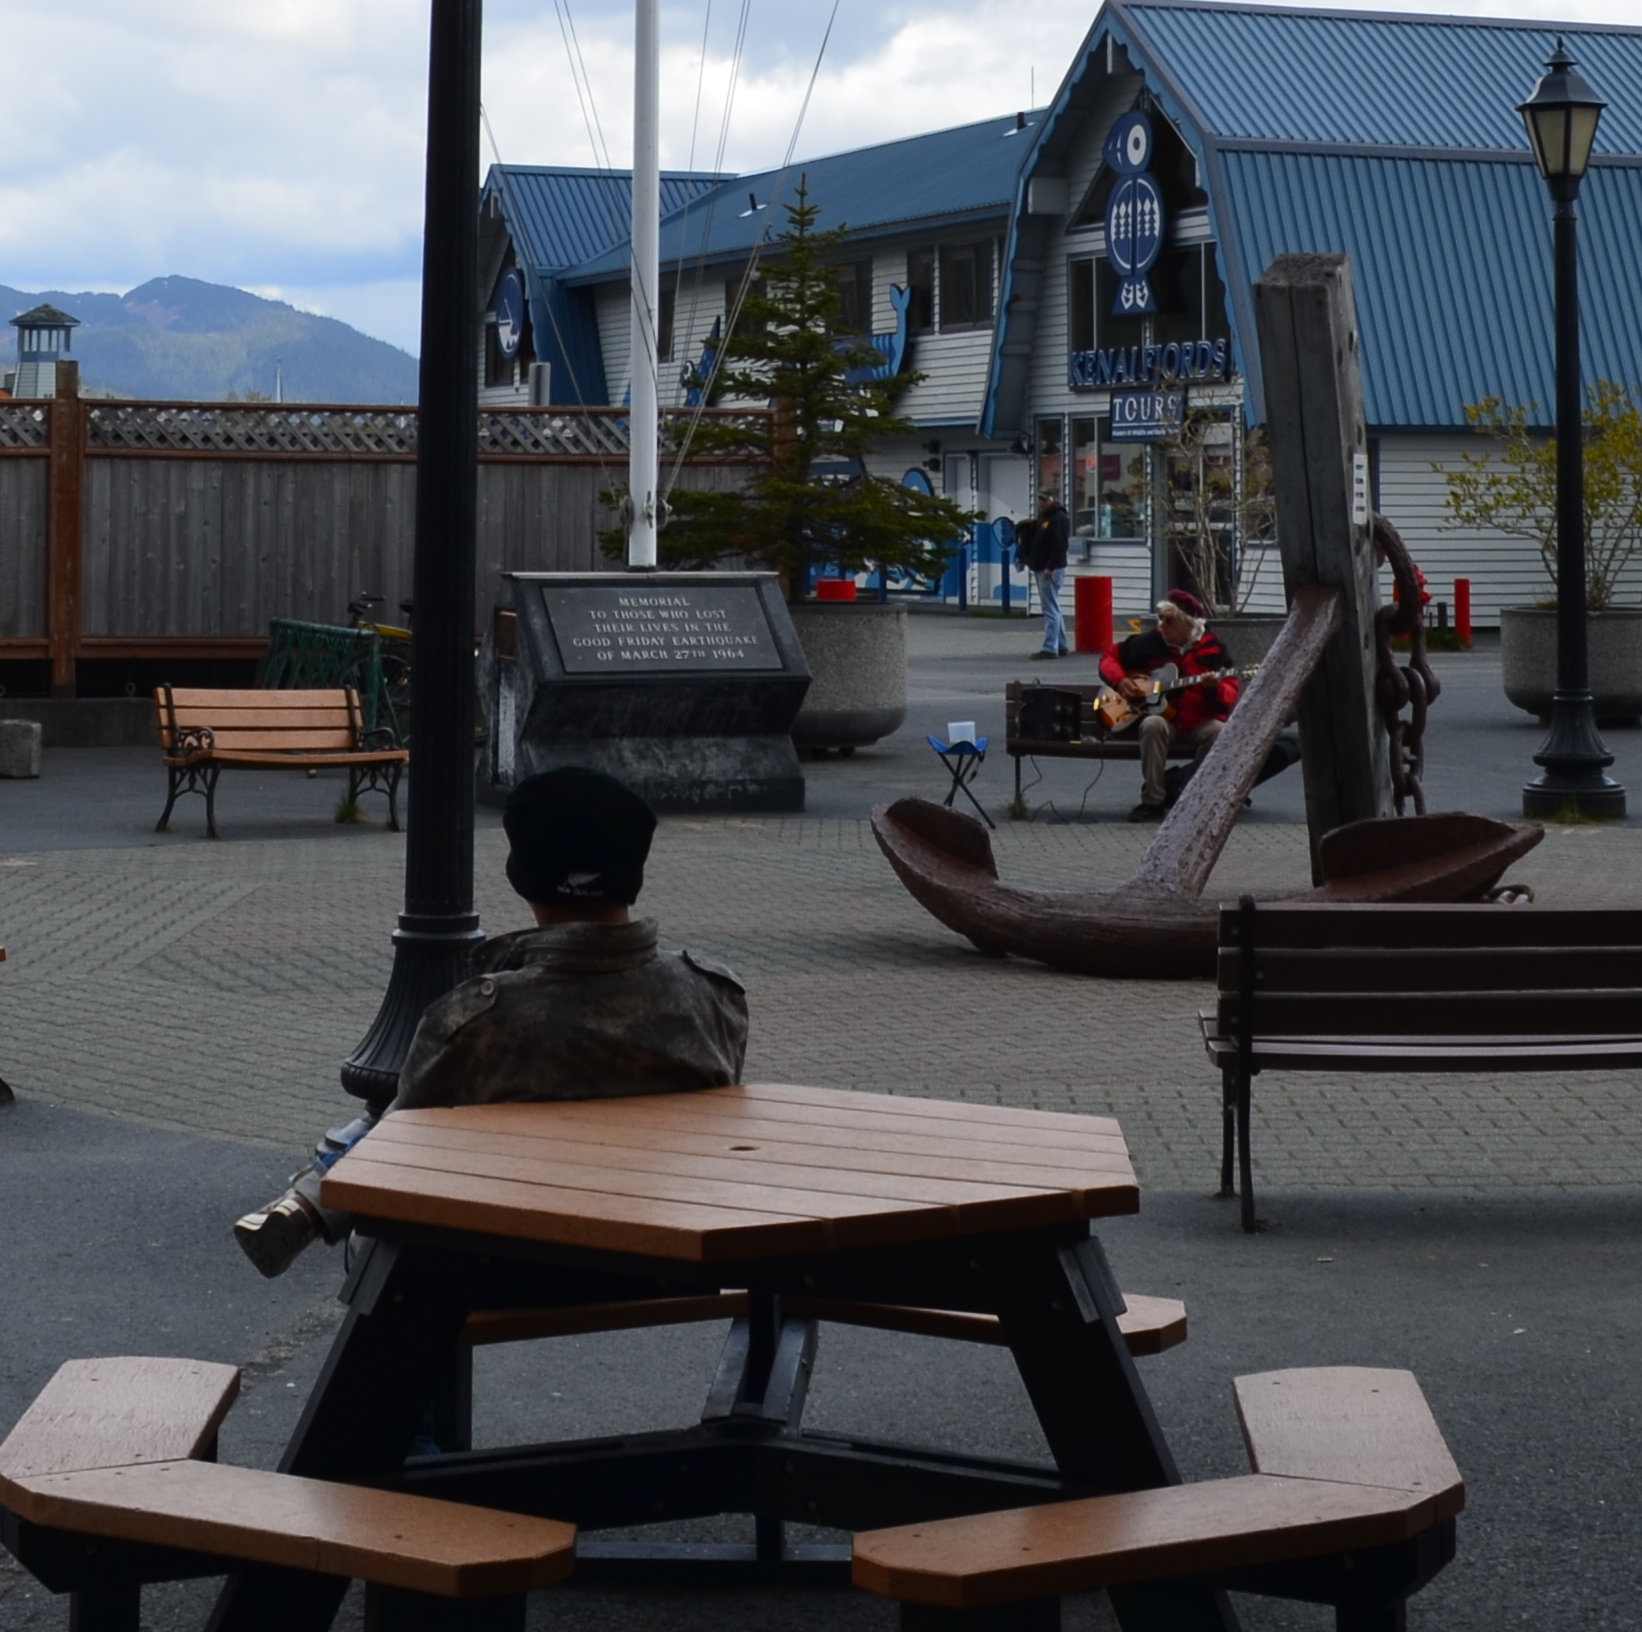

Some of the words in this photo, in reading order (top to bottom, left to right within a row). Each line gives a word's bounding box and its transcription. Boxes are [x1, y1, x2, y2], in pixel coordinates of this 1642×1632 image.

[1069, 346, 1138, 386] KENAI
[1141, 338, 1228, 389] FJORDS
[1113, 396, 1179, 421] TOURS
[619, 597, 690, 607] MEMORIAL
[589, 610, 607, 620] TO
[613, 610, 655, 620] THOSE
[659, 610, 689, 619] WHO
[695, 609, 727, 619] LOST
[594, 623, 634, 633] THEIR
[640, 623, 679, 633] LIVES
[684, 623, 699, 632] IN
[703, 622, 732, 632] THE
[573, 637, 611, 648] GOOD
[617, 637, 666, 647] FRIDAY
[672, 636, 760, 647] EARTHQUAKE
[597, 650, 614, 660] OF
[621, 650, 668, 660] MARCH
[712, 649, 745, 660] 1964
